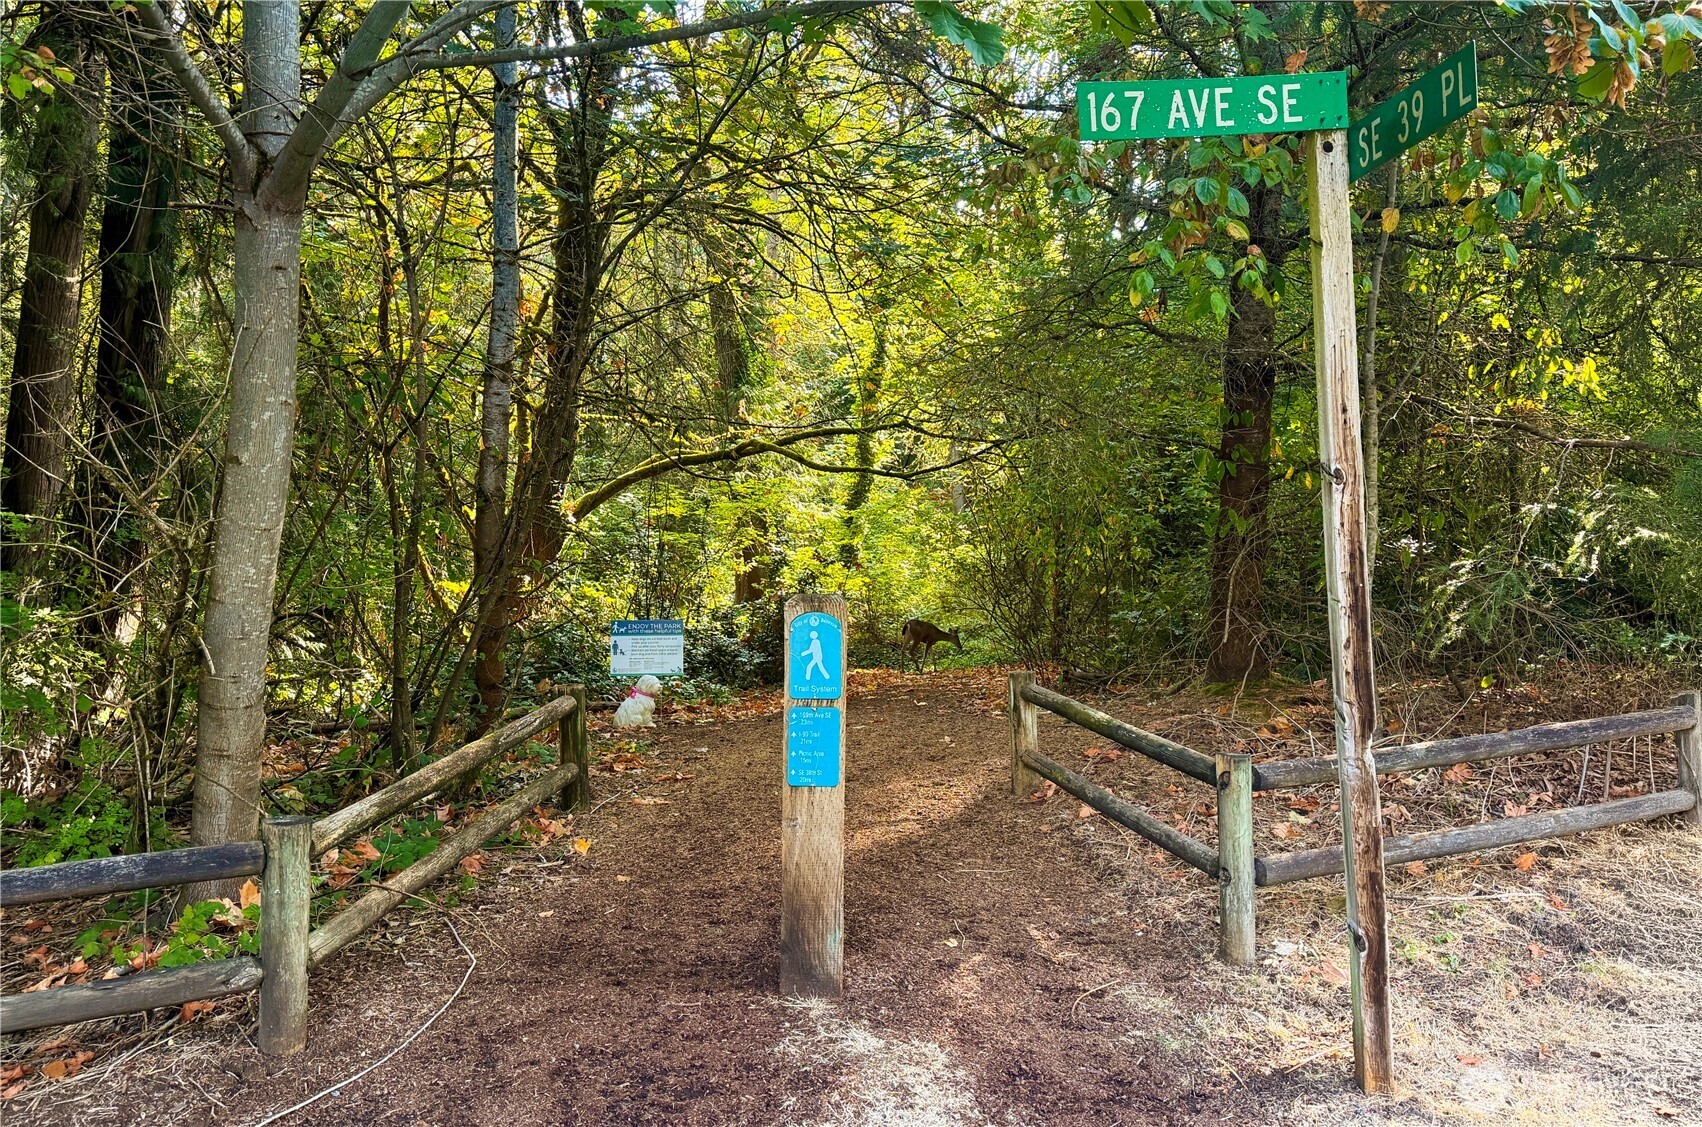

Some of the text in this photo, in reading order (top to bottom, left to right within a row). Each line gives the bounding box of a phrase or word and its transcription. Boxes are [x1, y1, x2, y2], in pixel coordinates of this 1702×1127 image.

[1087, 83, 1303, 133] 167 AVE SE
[1358, 61, 1473, 169] SE 39 PL
[811, 685, 837, 694] System
